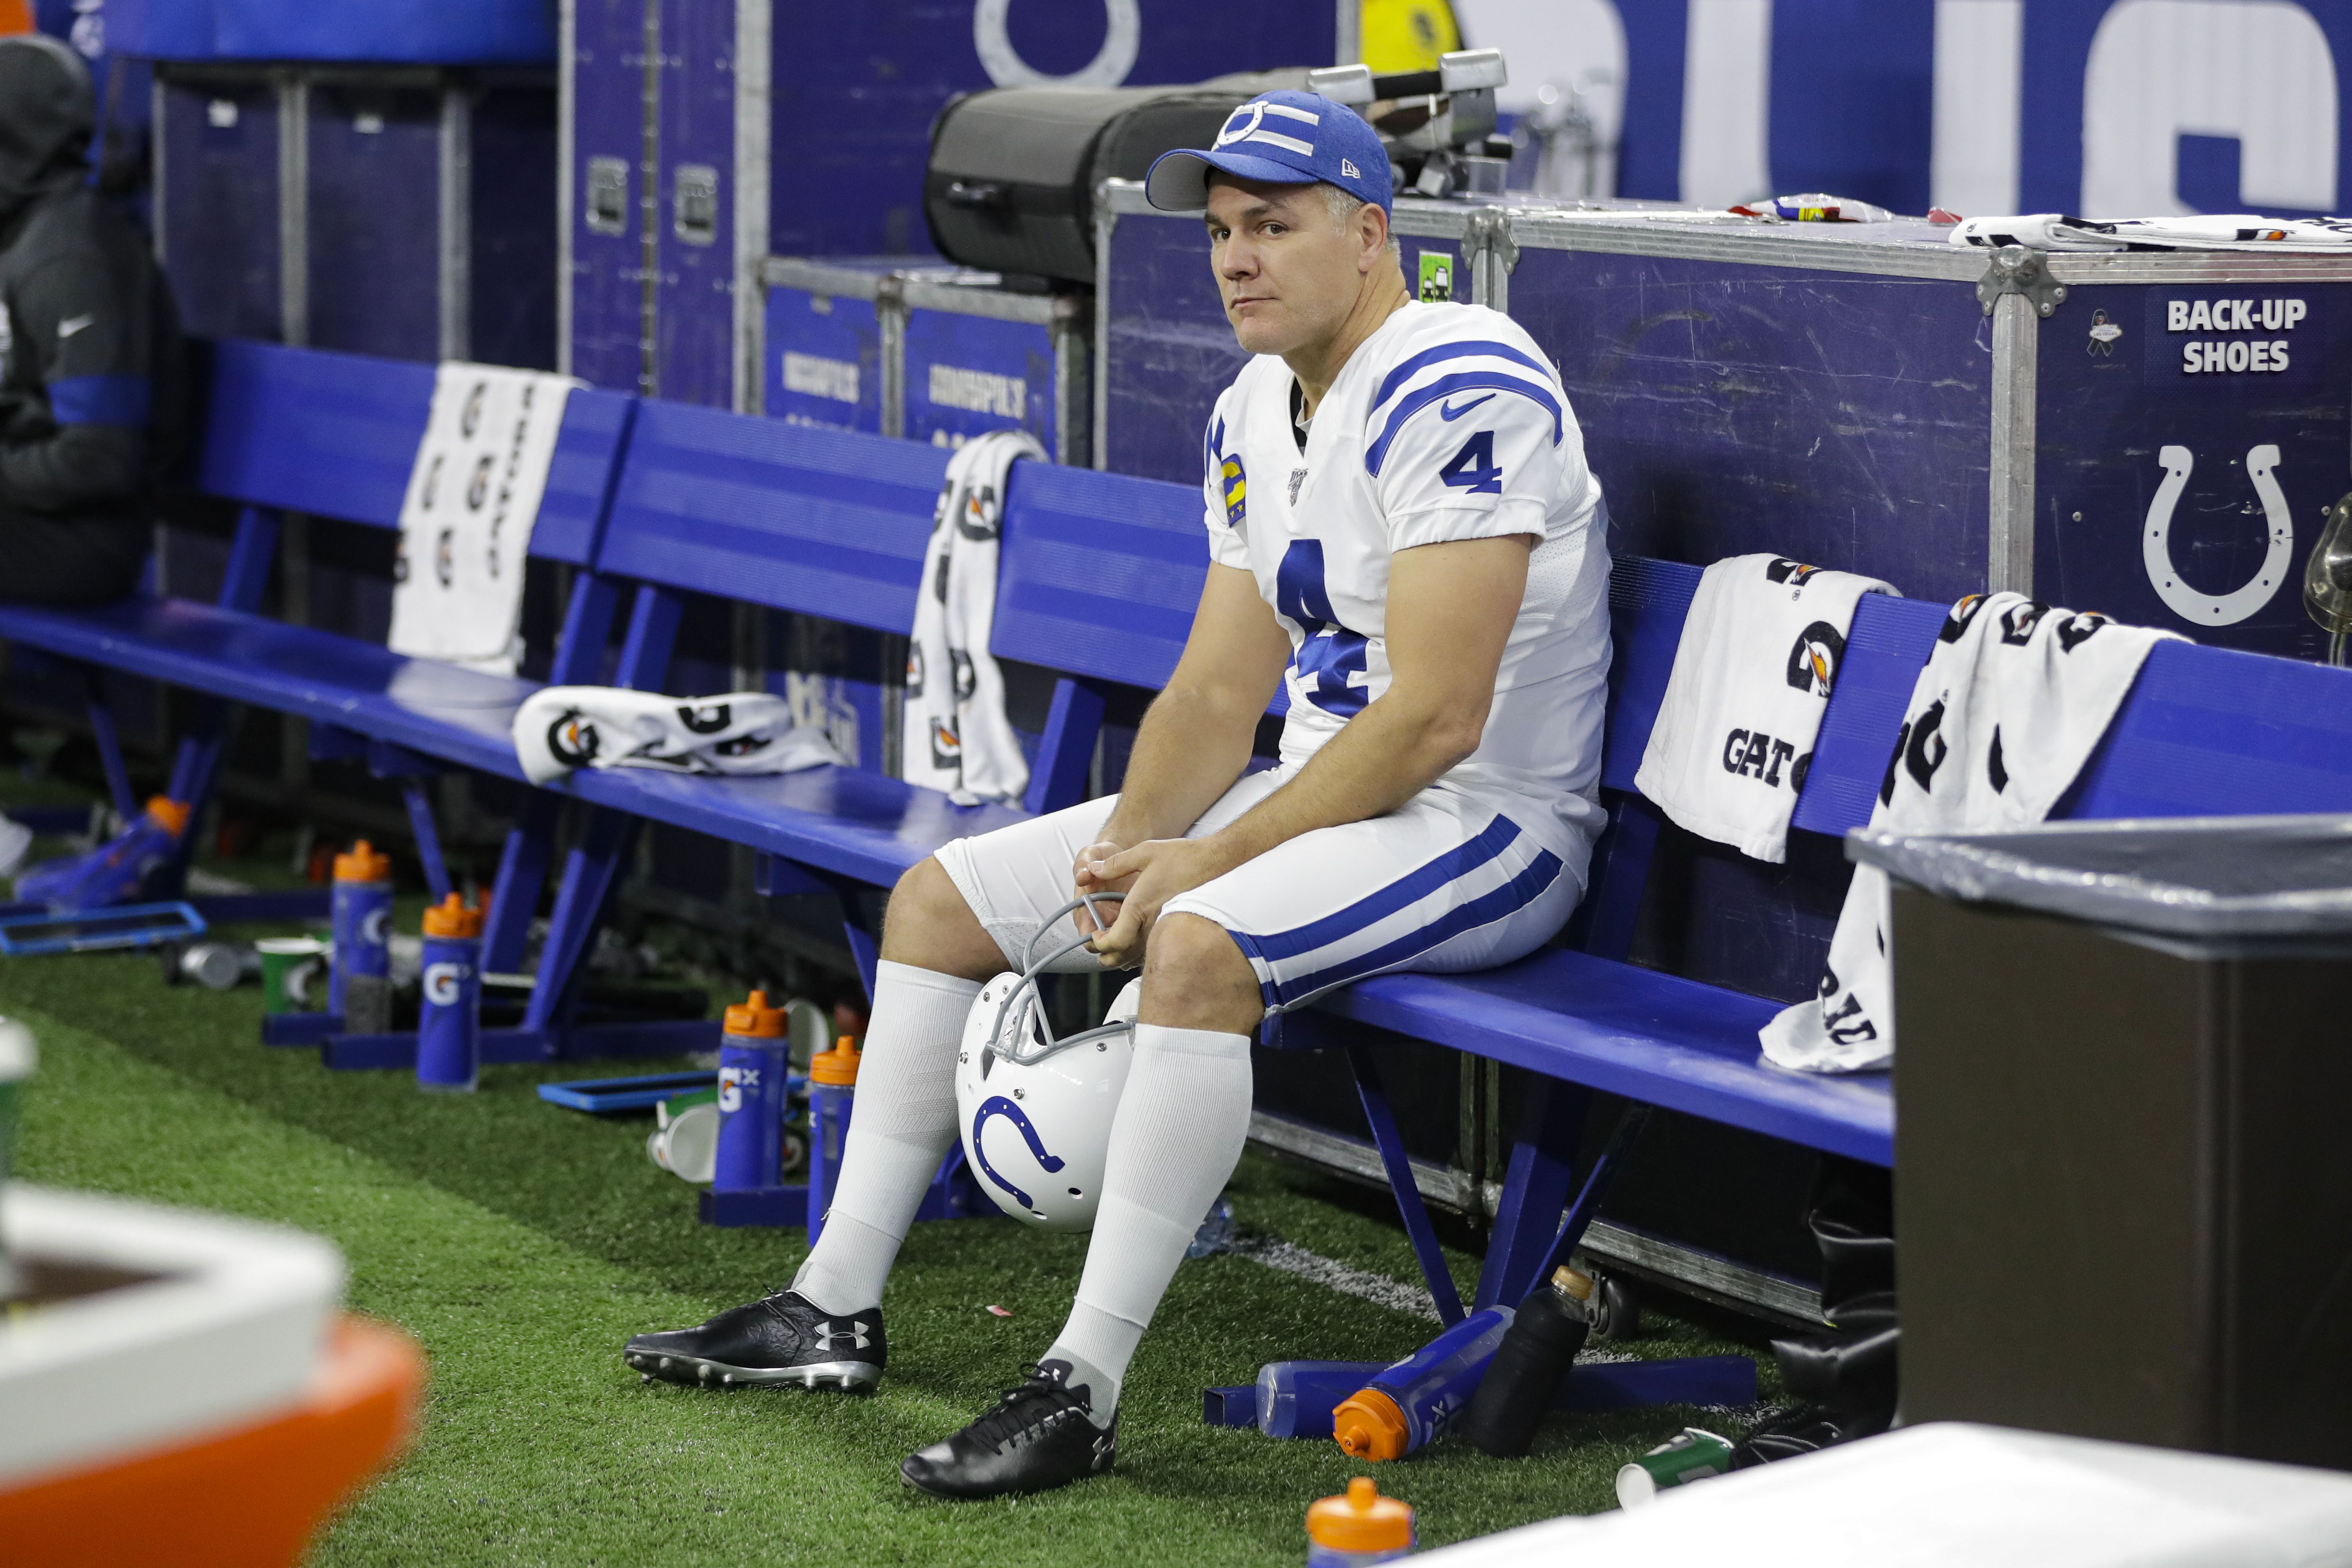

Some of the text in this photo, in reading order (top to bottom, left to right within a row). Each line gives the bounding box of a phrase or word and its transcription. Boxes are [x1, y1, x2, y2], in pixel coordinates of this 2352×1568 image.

[2168, 299, 2307, 331] BACK-UP
[2183, 341, 2290, 373] SHOES
[1439, 430, 1502, 495] 4
[1277, 539, 1370, 718] 4
